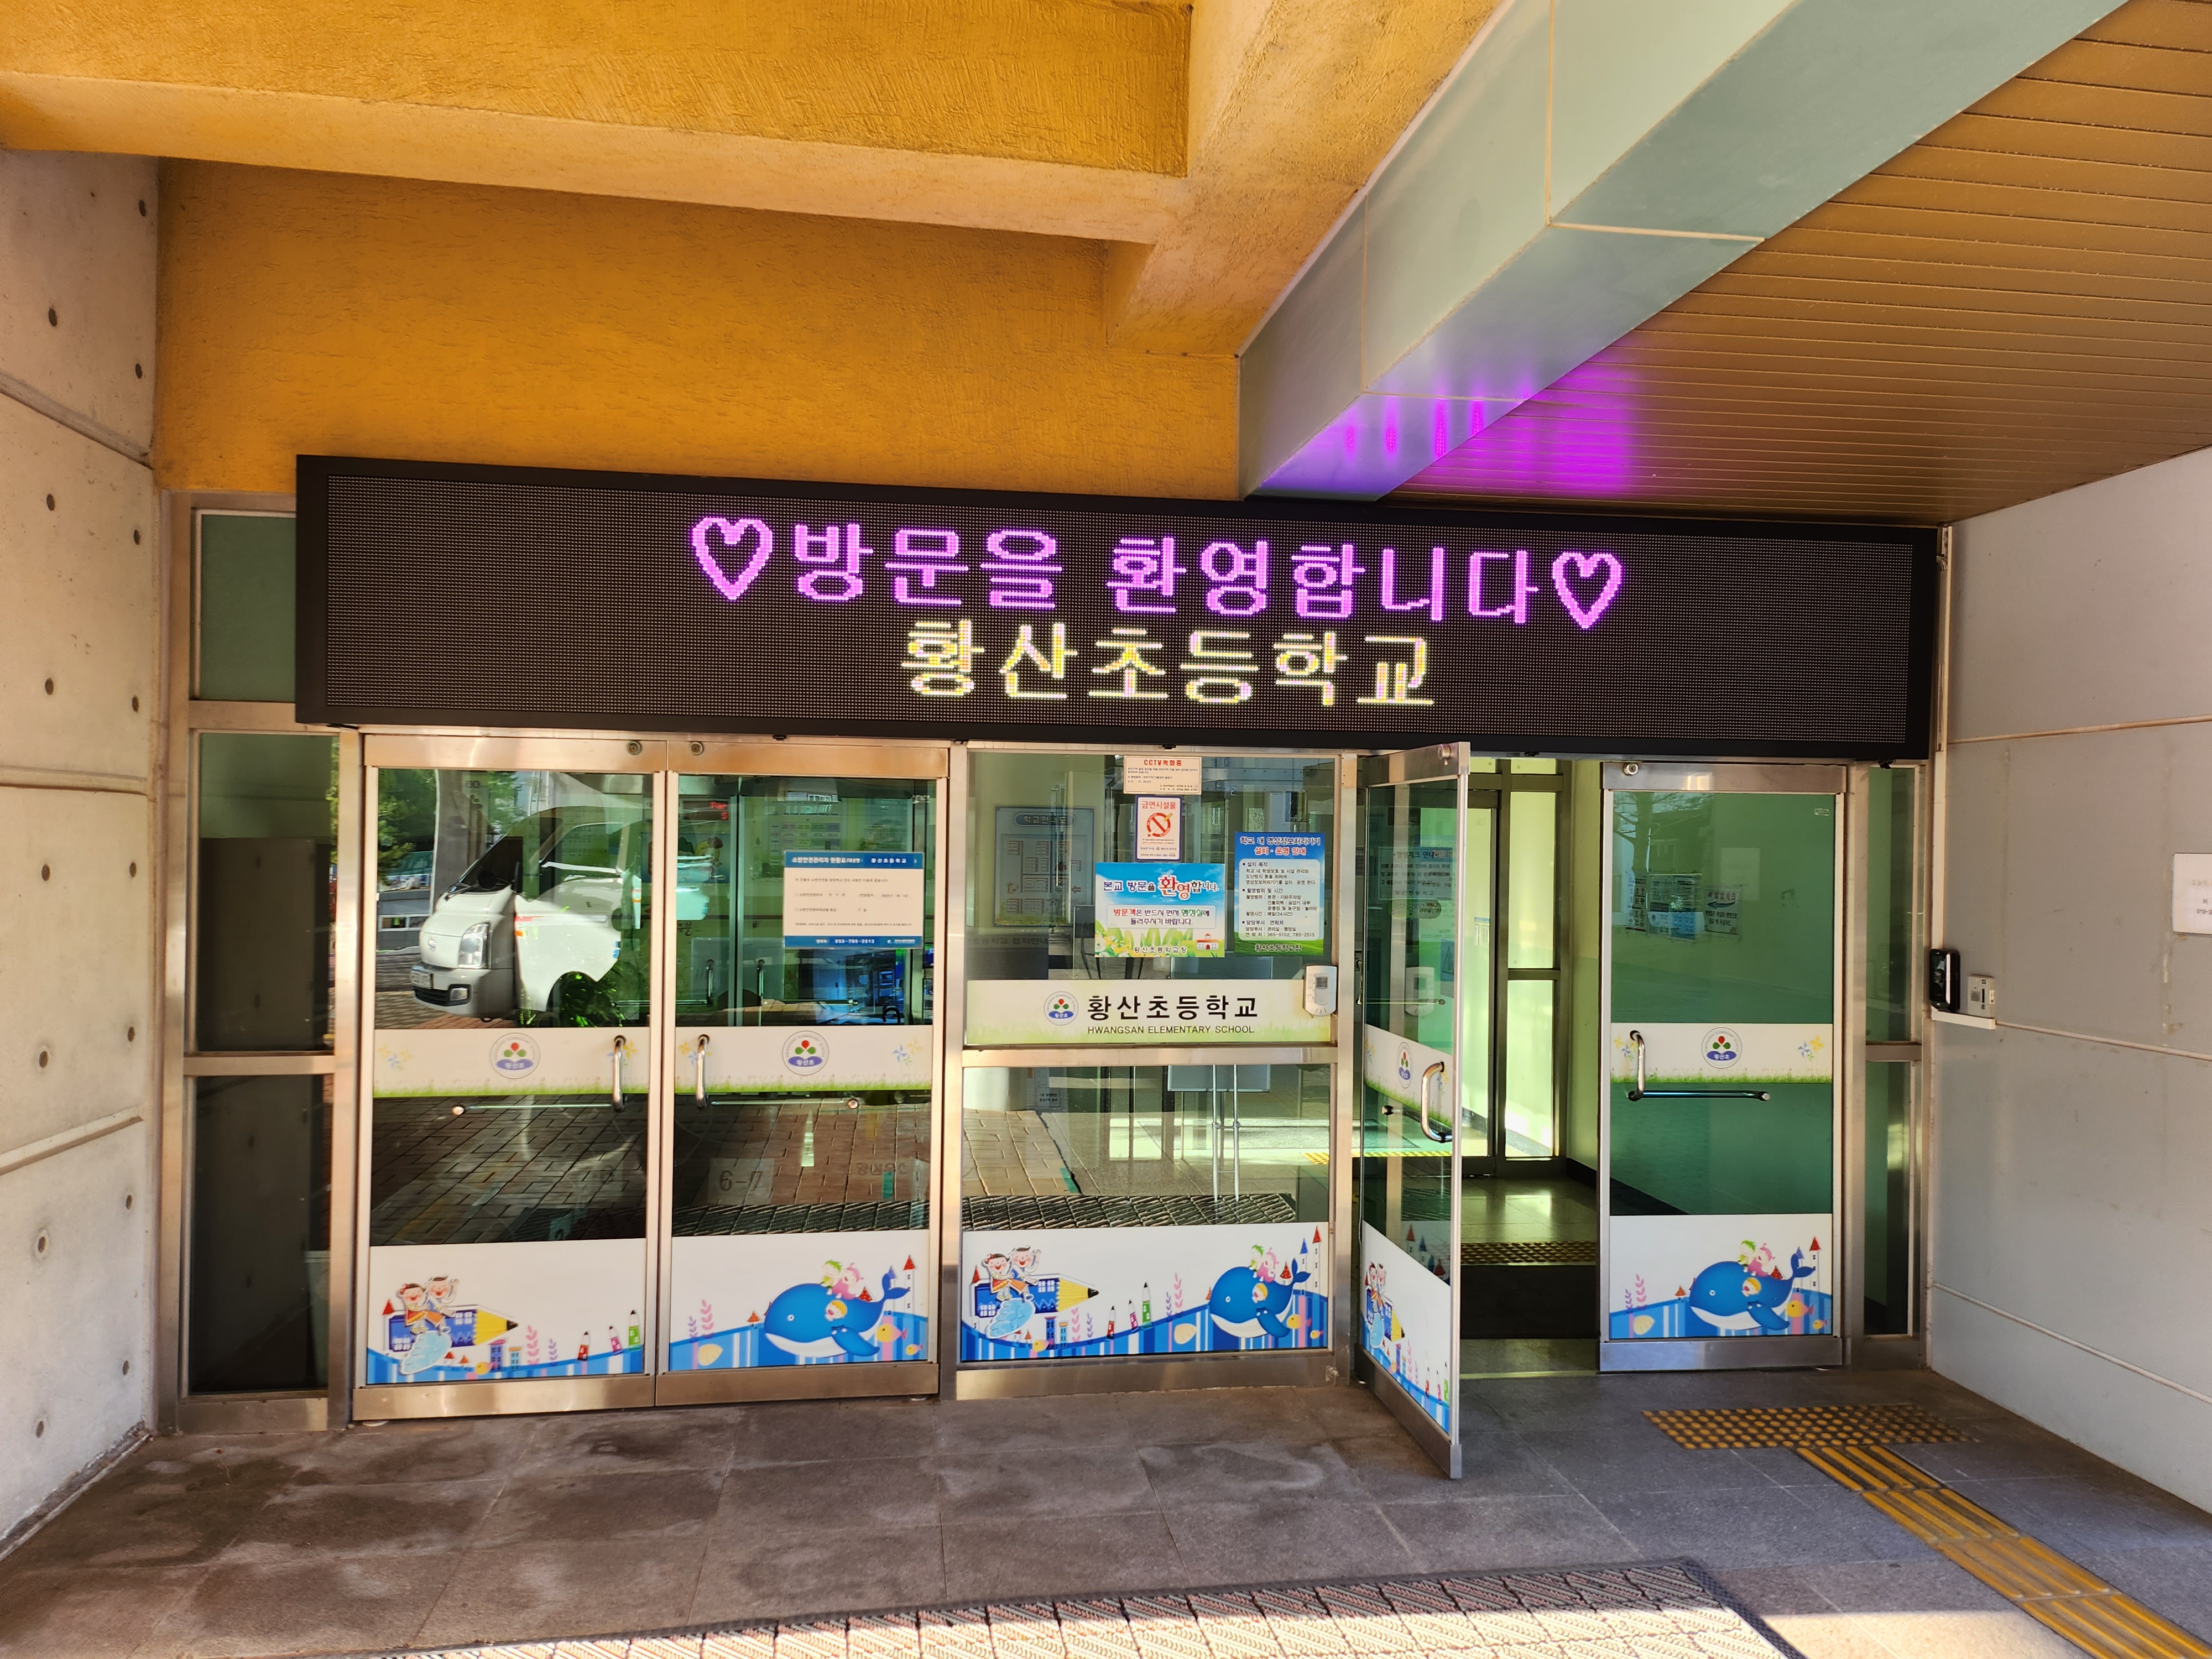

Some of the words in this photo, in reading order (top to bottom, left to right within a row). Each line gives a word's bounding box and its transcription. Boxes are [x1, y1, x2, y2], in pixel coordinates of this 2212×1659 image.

[795, 523, 1062, 608] 방문을
[1107, 536, 1540, 624] 환영합니다
[901, 619, 1434, 705] 황산초등학교
[1142, 801, 1176, 810] 금연시설물
[1241, 836, 1255, 844] 학교
[1258, 837, 1265, 845] 내
[1255, 847, 1269, 855] 설치
[1292, 847, 1306, 855] 안내
[1103, 881, 1123, 891] 본교
[1128, 881, 1155, 892] 방문을
[1159, 876, 1219, 900] 환영합니다.
[1113, 909, 1142, 917] 방문객은
[1087, 995, 1258, 1021] 황산초등학교
[1088, 1026, 1144, 1034] HWANGSAN
